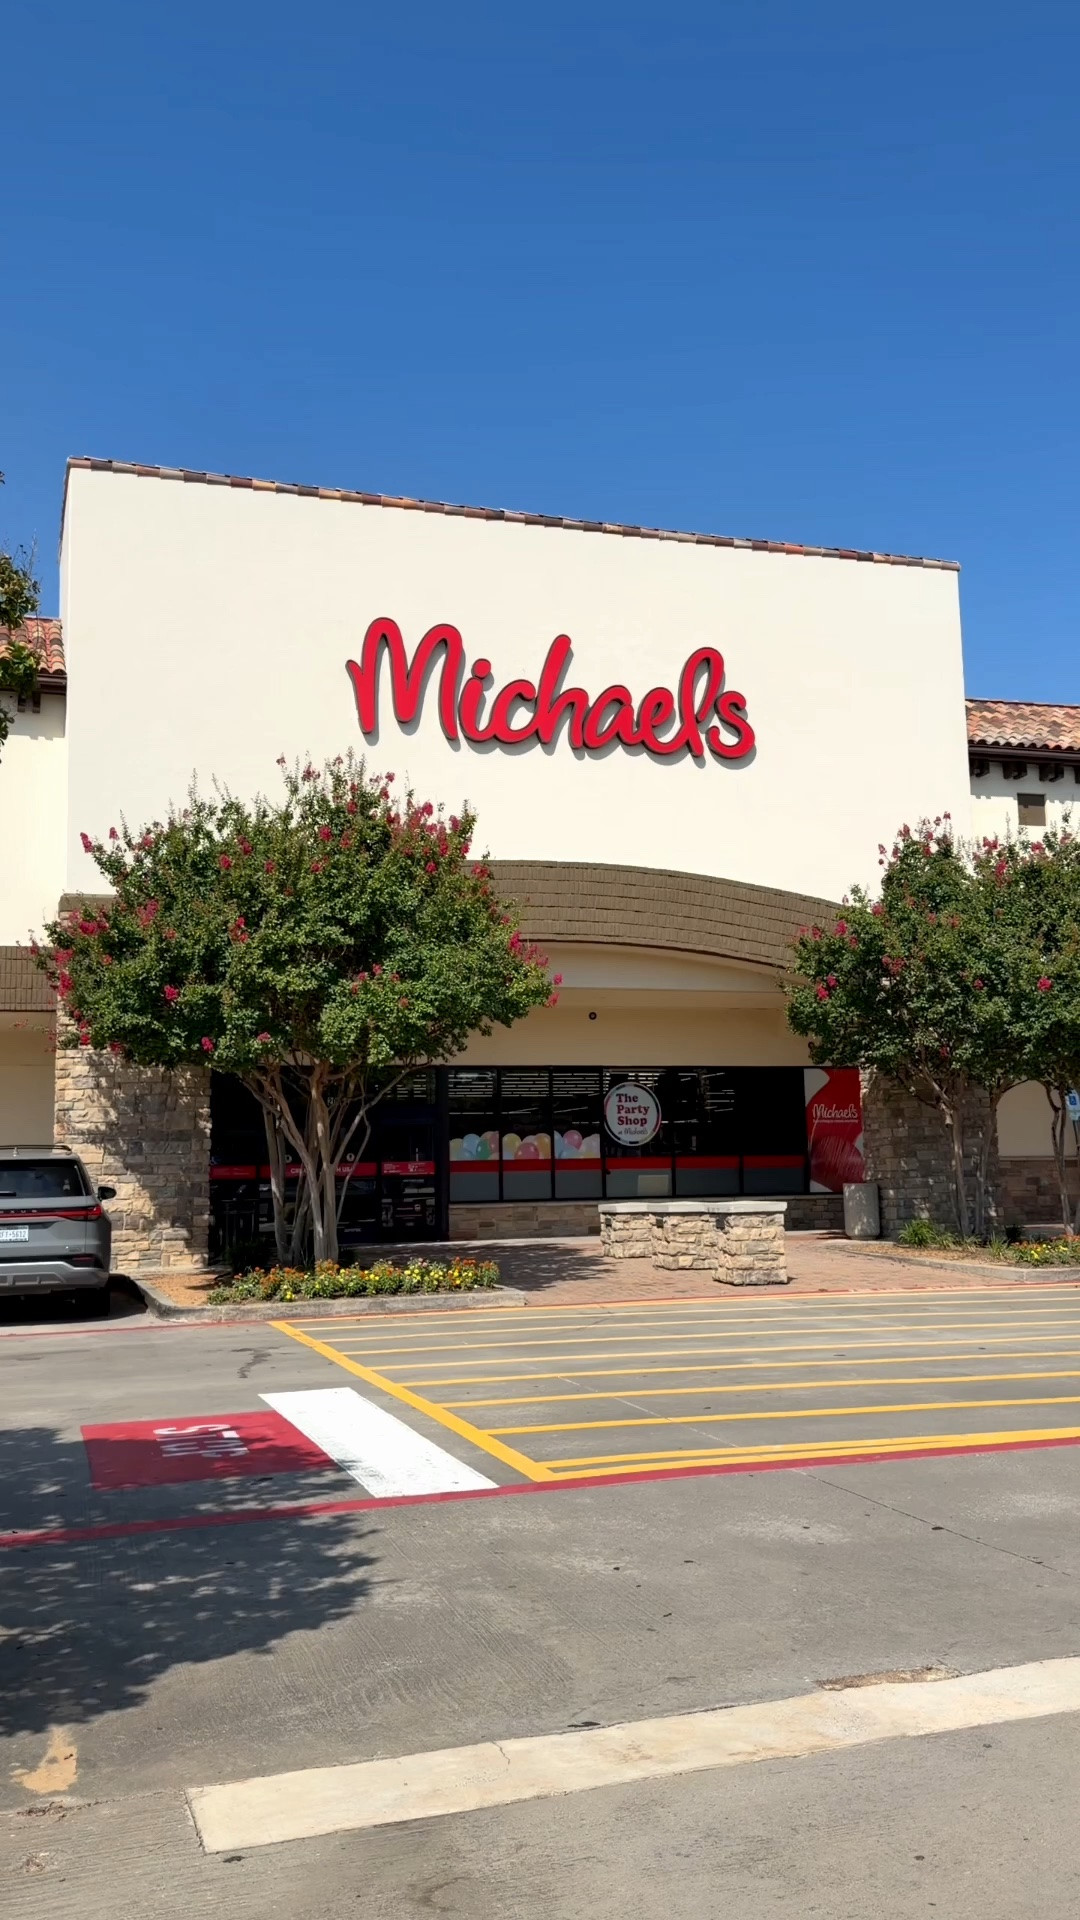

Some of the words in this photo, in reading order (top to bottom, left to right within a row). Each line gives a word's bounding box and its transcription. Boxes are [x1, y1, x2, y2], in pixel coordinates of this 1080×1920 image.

[346, 617, 755, 758] Michaels
[616, 1093, 639, 1103] The
[616, 1104, 650, 1115] Party
[812, 1104, 858, 1119] Michaels
[617, 1116, 648, 1127] Shop
